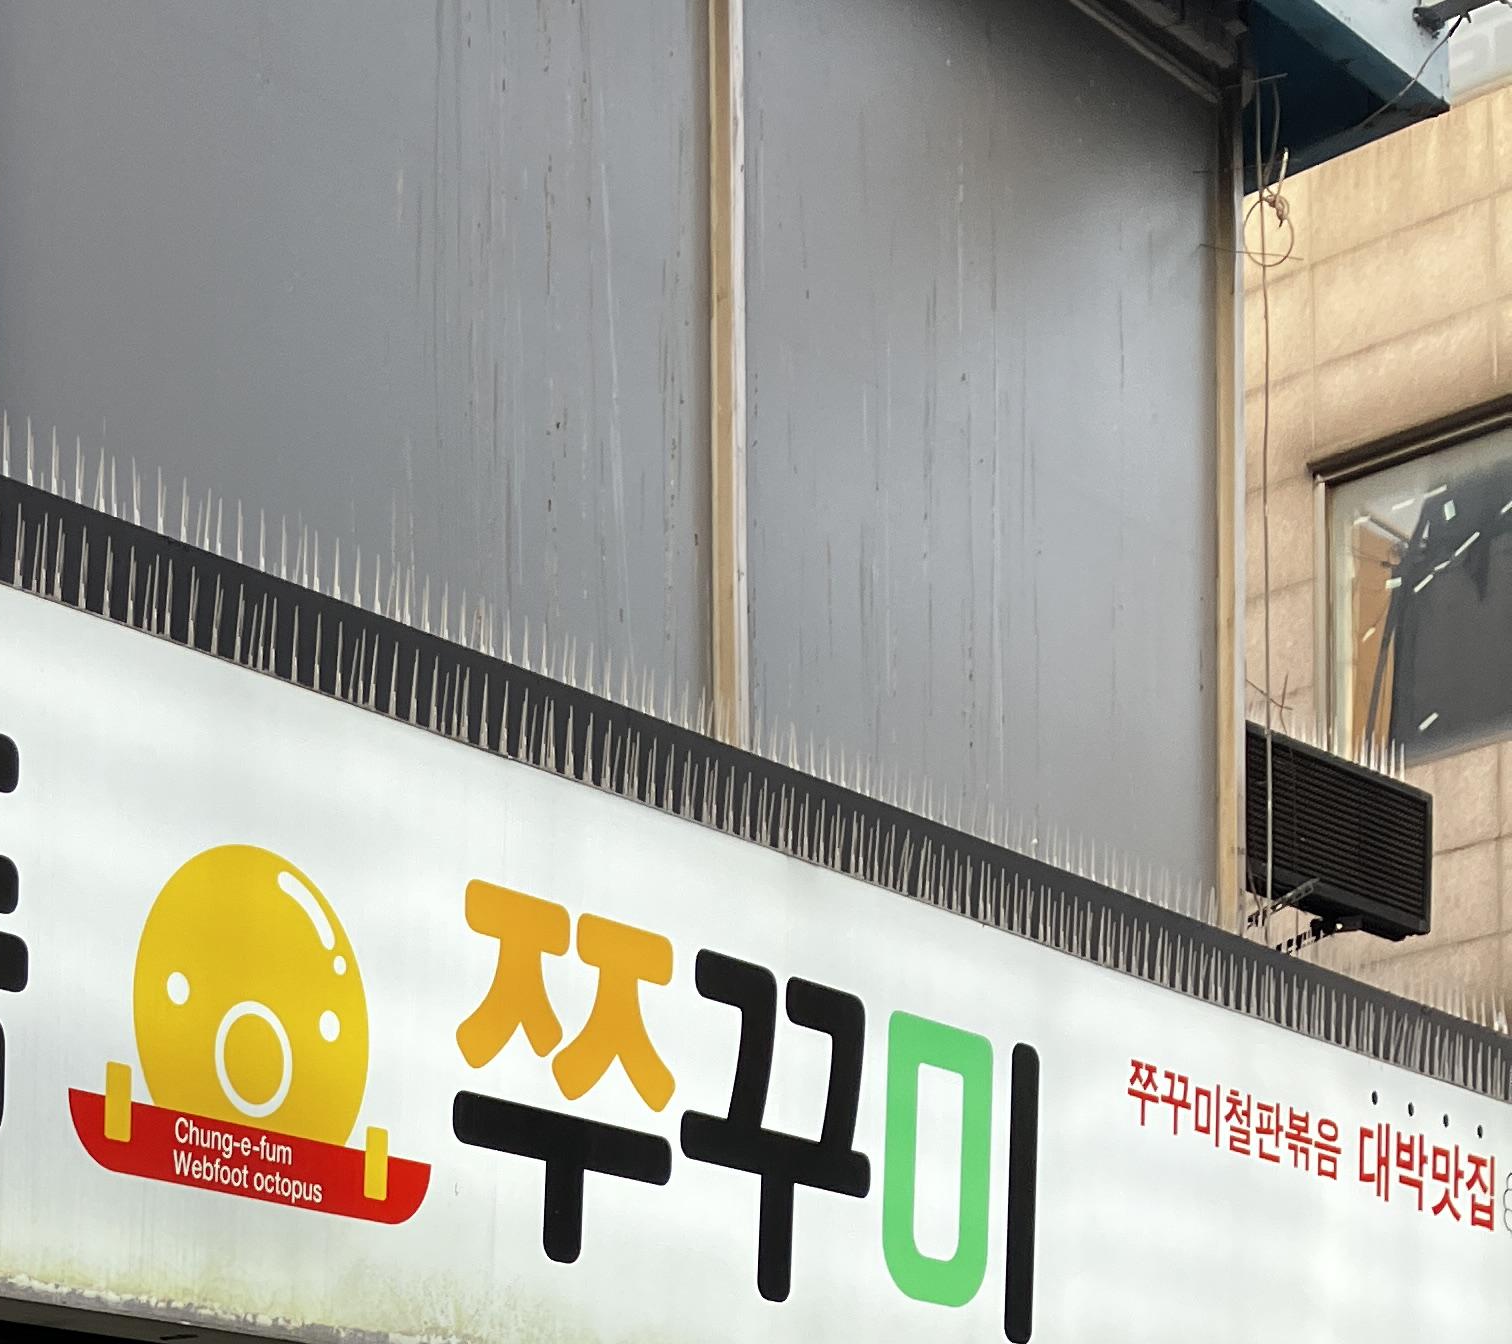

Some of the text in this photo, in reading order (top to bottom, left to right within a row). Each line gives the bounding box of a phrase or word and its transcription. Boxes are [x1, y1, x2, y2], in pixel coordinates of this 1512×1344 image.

[173, 1116, 293, 1166] Chung-e-fum
[450, 880, 1040, 1344] 쭈꾸미
[1127, 1058, 1496, 1232] 쭈꾸미철판볶음 대박맛집
[172, 1149, 324, 1204] Webfoot octopus
